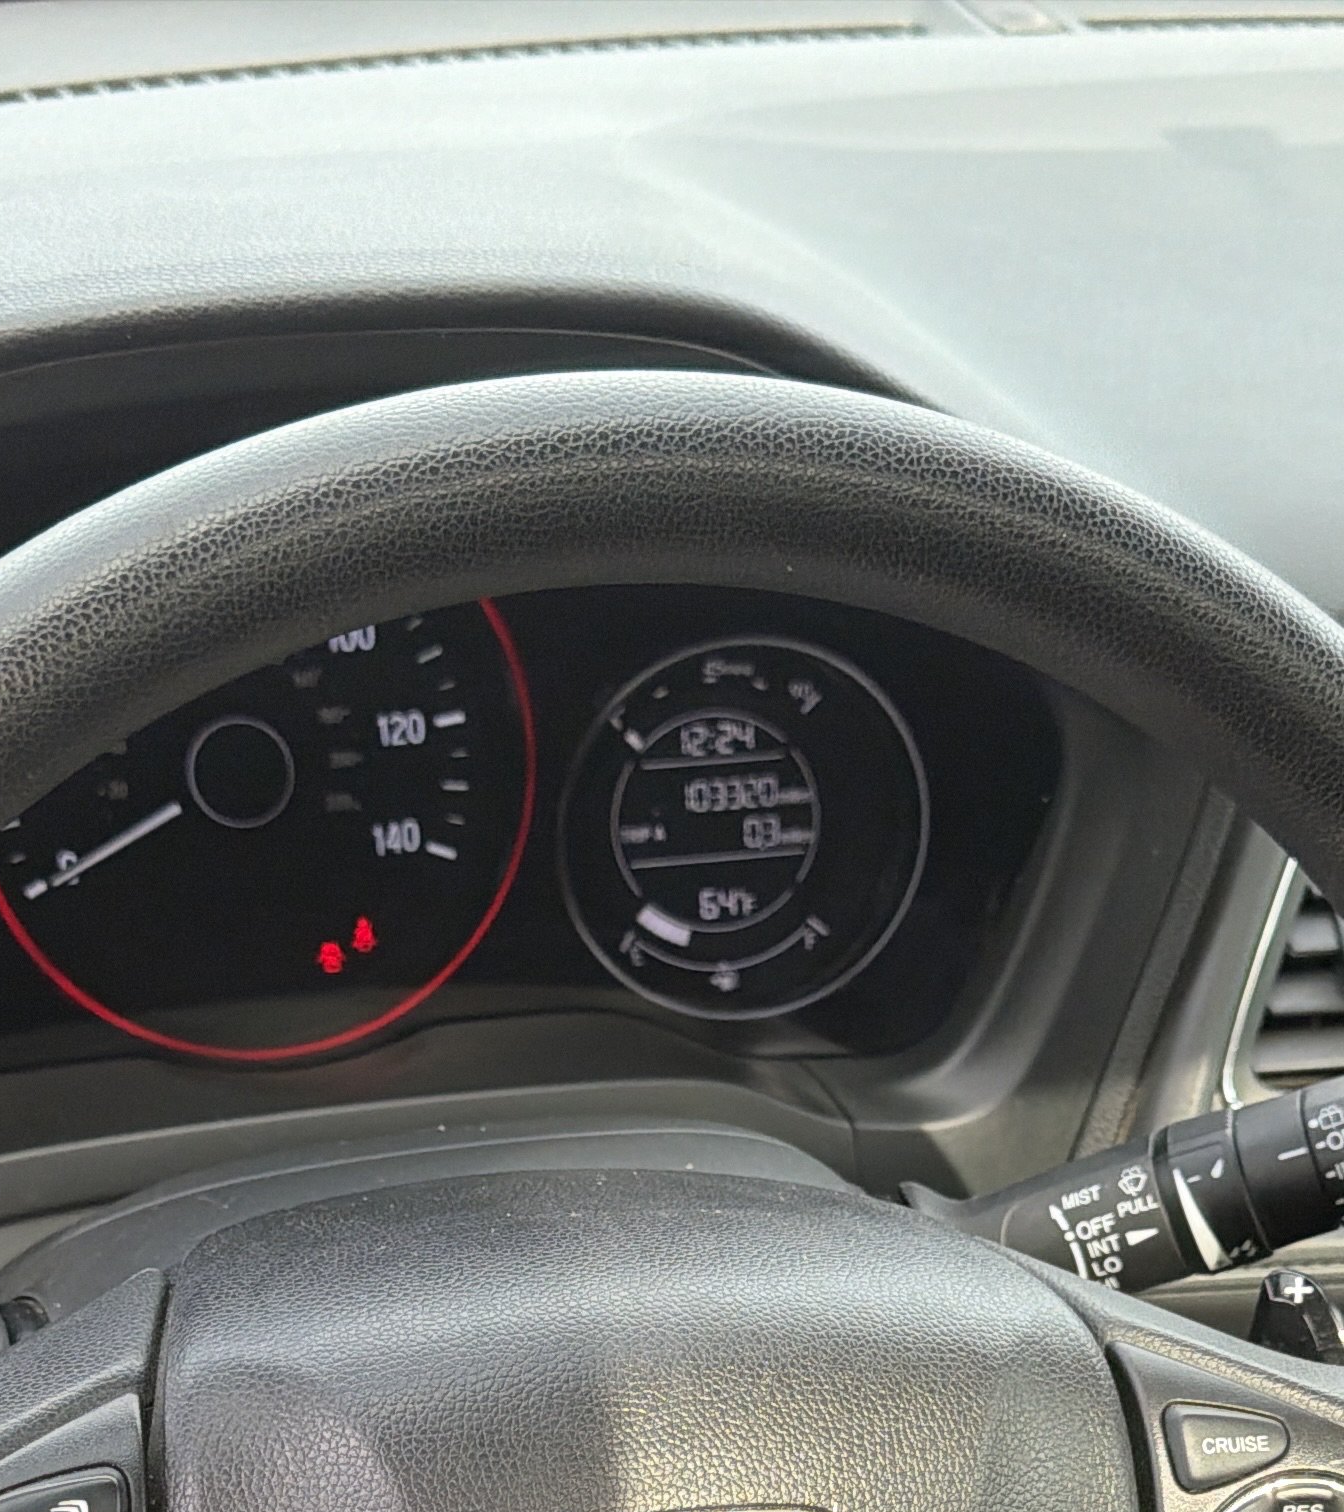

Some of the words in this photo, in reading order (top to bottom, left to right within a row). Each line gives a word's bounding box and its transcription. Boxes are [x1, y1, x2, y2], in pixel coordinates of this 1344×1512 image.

[376, 710, 425, 747] 120
[372, 818, 421, 856] 140
[1061, 1184, 1101, 1210] MIST
[1116, 1193, 1160, 1218] PULL
[1076, 1212, 1116, 1240] OFF
[1086, 1233, 1121, 1258] INT
[1091, 1256, 1124, 1277] LO
[1202, 1435, 1270, 1456] CRUISE
